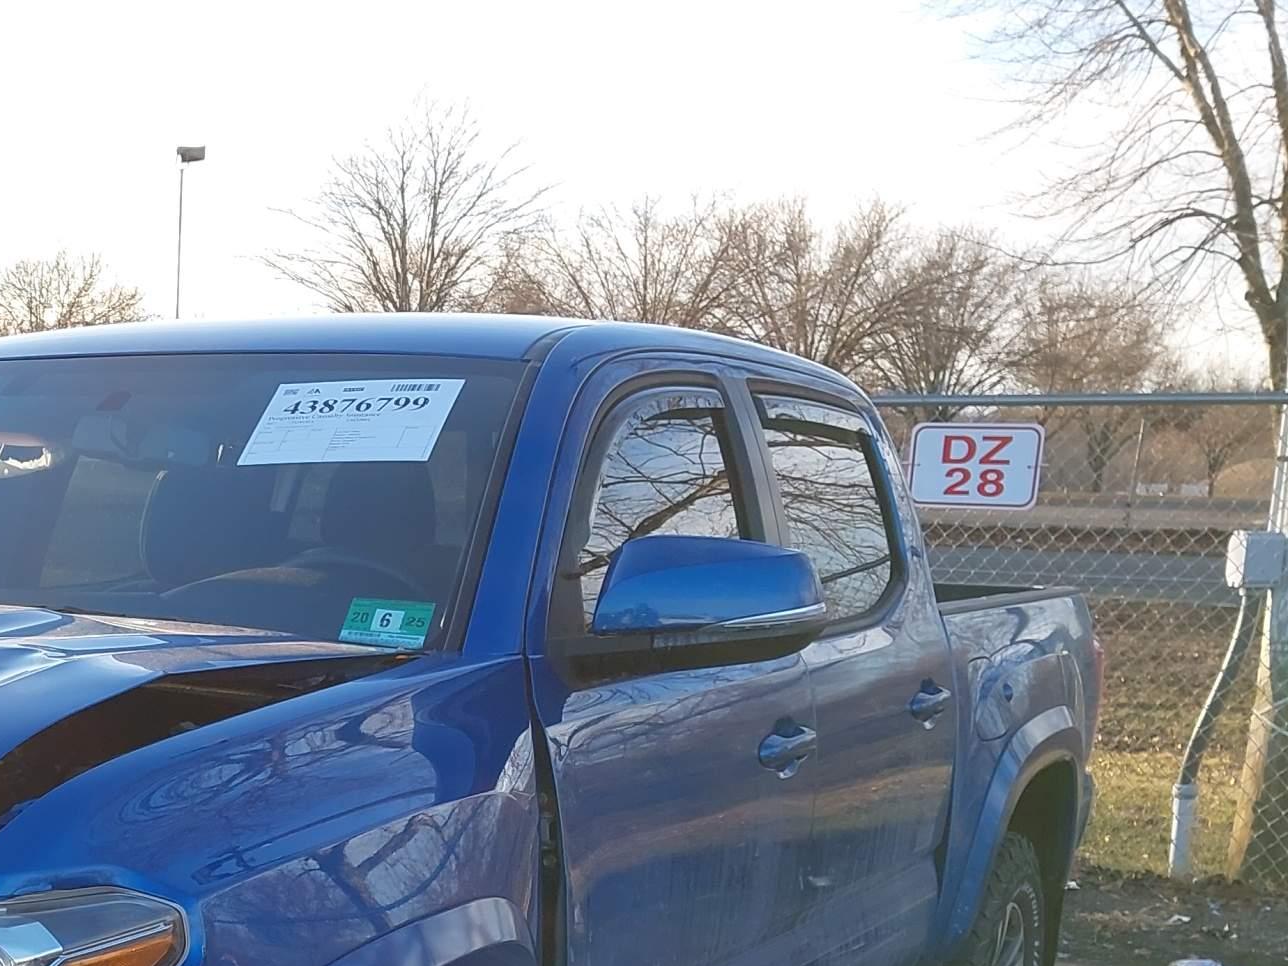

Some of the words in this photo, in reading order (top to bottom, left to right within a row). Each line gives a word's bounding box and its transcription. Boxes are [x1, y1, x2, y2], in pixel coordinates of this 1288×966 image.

[283, 395, 430, 415] 43876799
[941, 434, 1014, 465] DZ
[943, 467, 1005, 498] 28
[351, 611, 370, 624] 20
[379, 612, 393, 628] 6
[406, 616, 425, 628] 25
